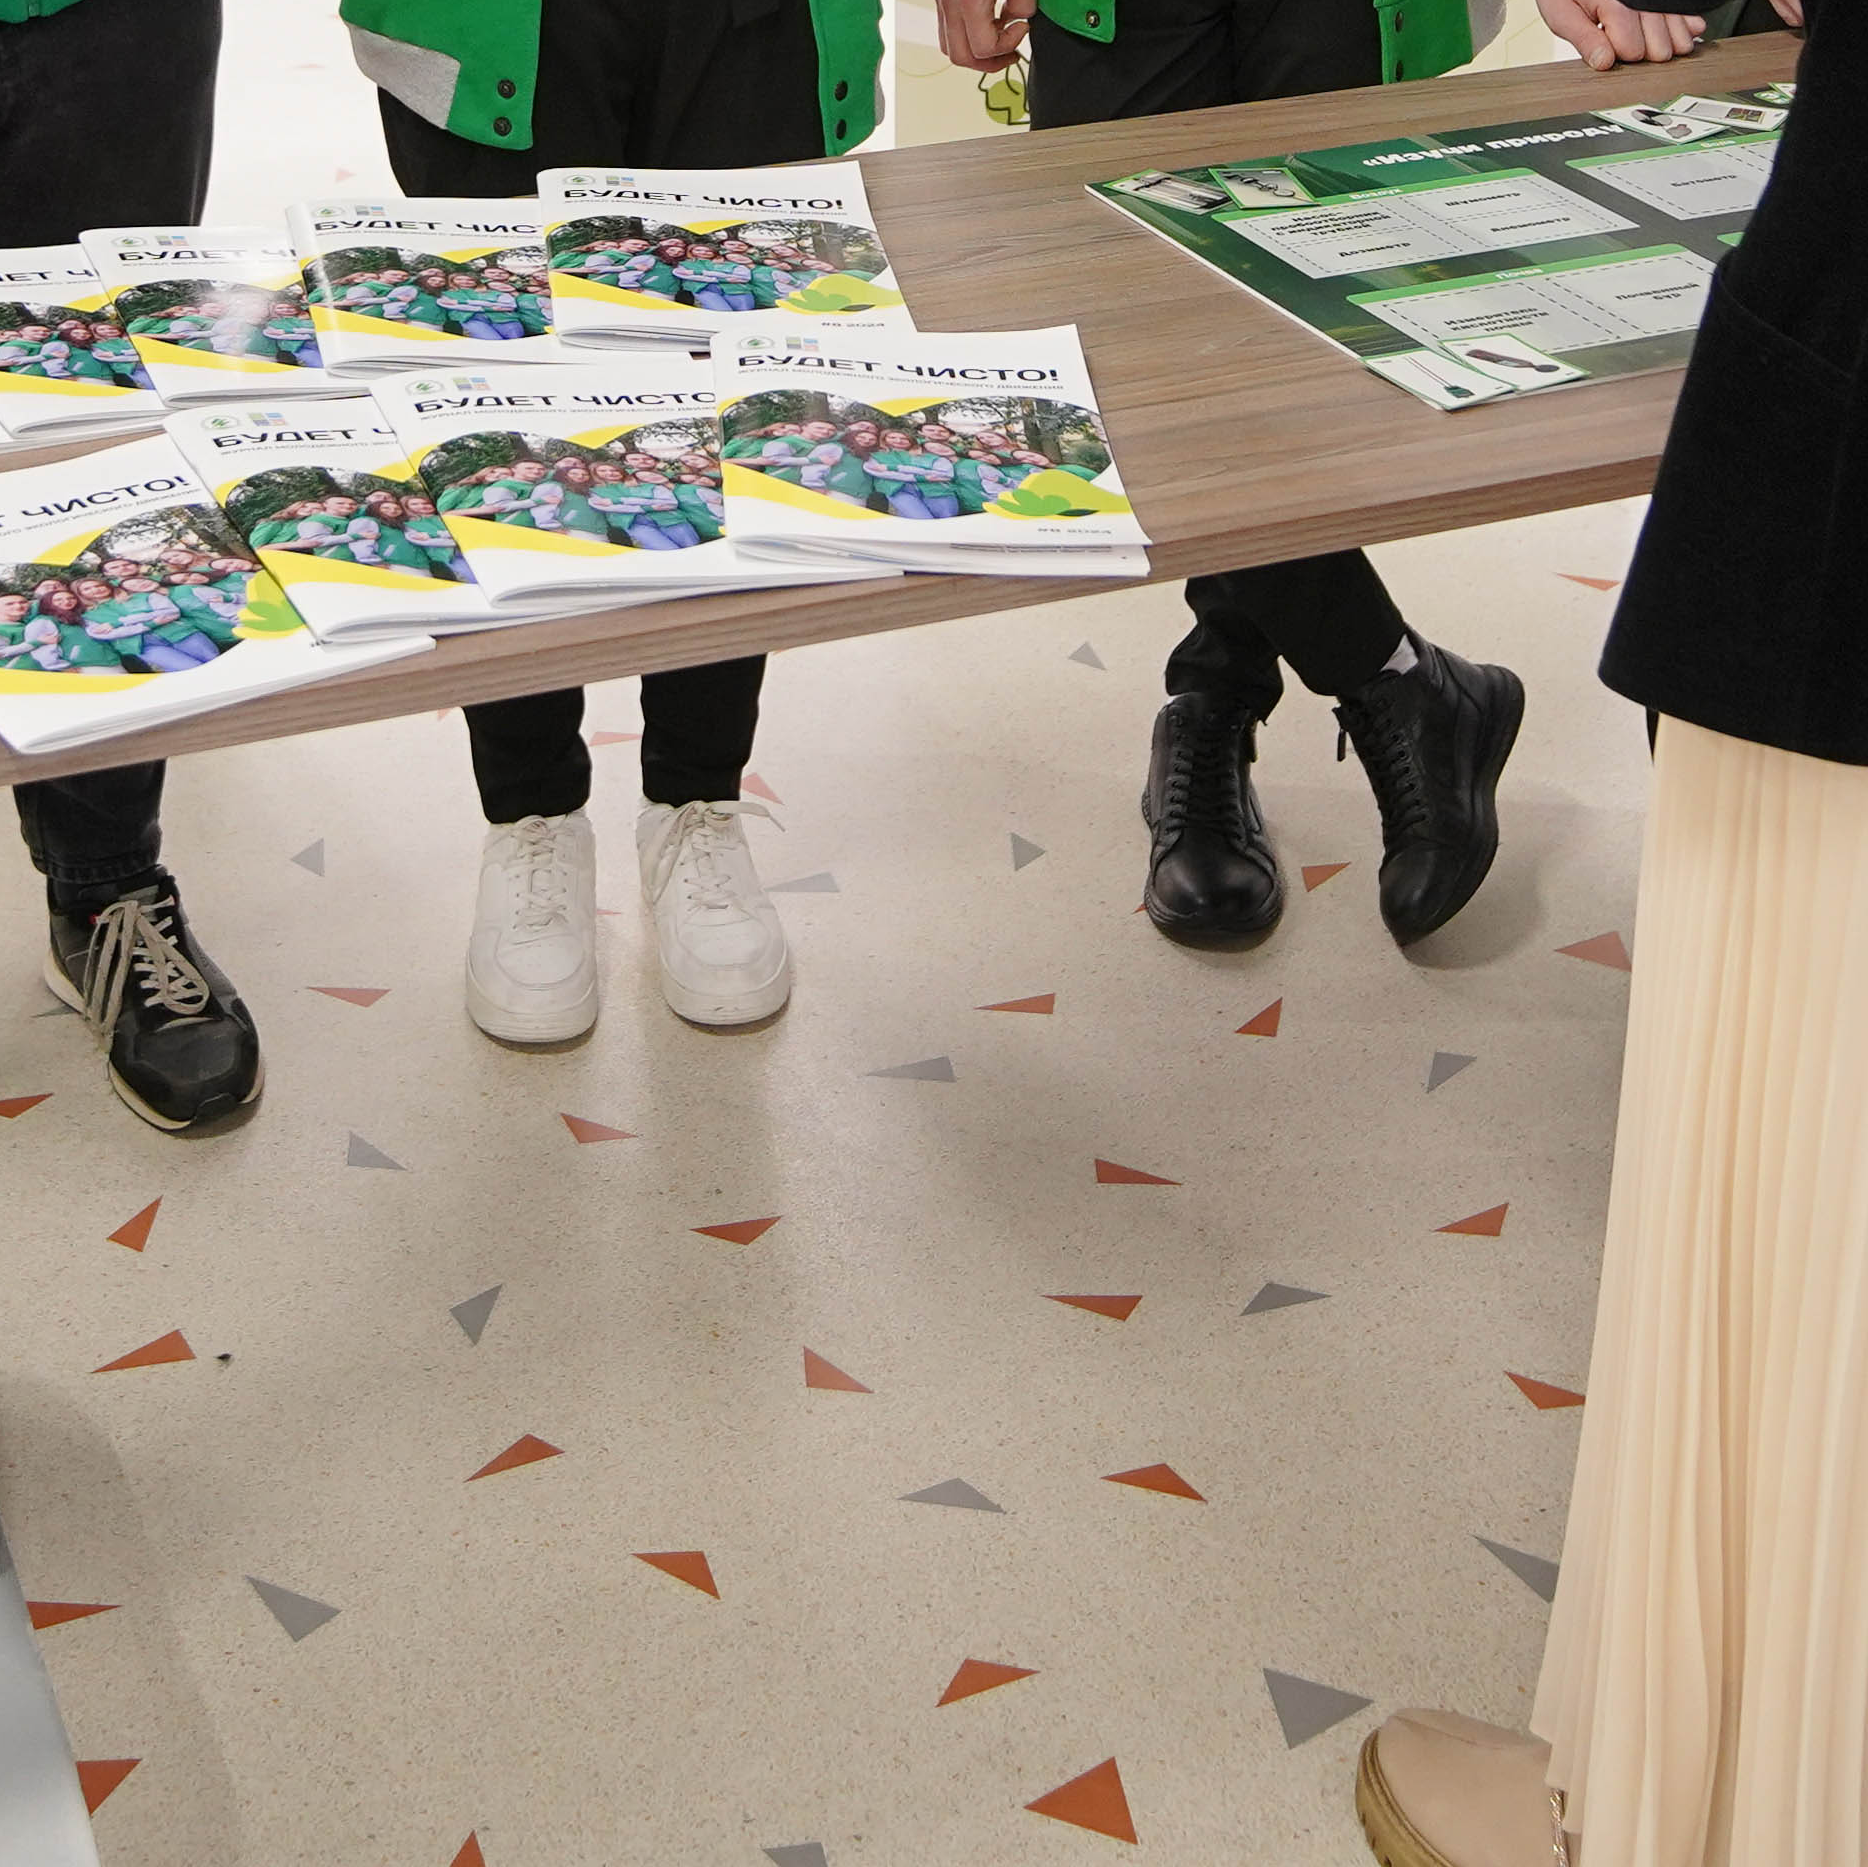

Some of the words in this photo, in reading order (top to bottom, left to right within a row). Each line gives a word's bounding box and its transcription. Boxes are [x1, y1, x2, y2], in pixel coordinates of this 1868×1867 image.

[564, 189, 690, 202] БУДЕТ
[703, 195, 844, 211] ЧИСТО!
[314, 219, 443, 231] БУДЕТ
[456, 222, 542, 233] ЧИС
[118, 249, 246, 261] БУДЕТ
[738, 354, 883, 373] БУДЕТ
[897, 364, 1060, 383] ЧИСТО!
[414, 395, 557, 414] БУДЕТ
[573, 392, 716, 406] ЧИСТО
[213, 429, 357, 448] БУДЕТ
[22, 474, 190, 518] ЧИСТО!
